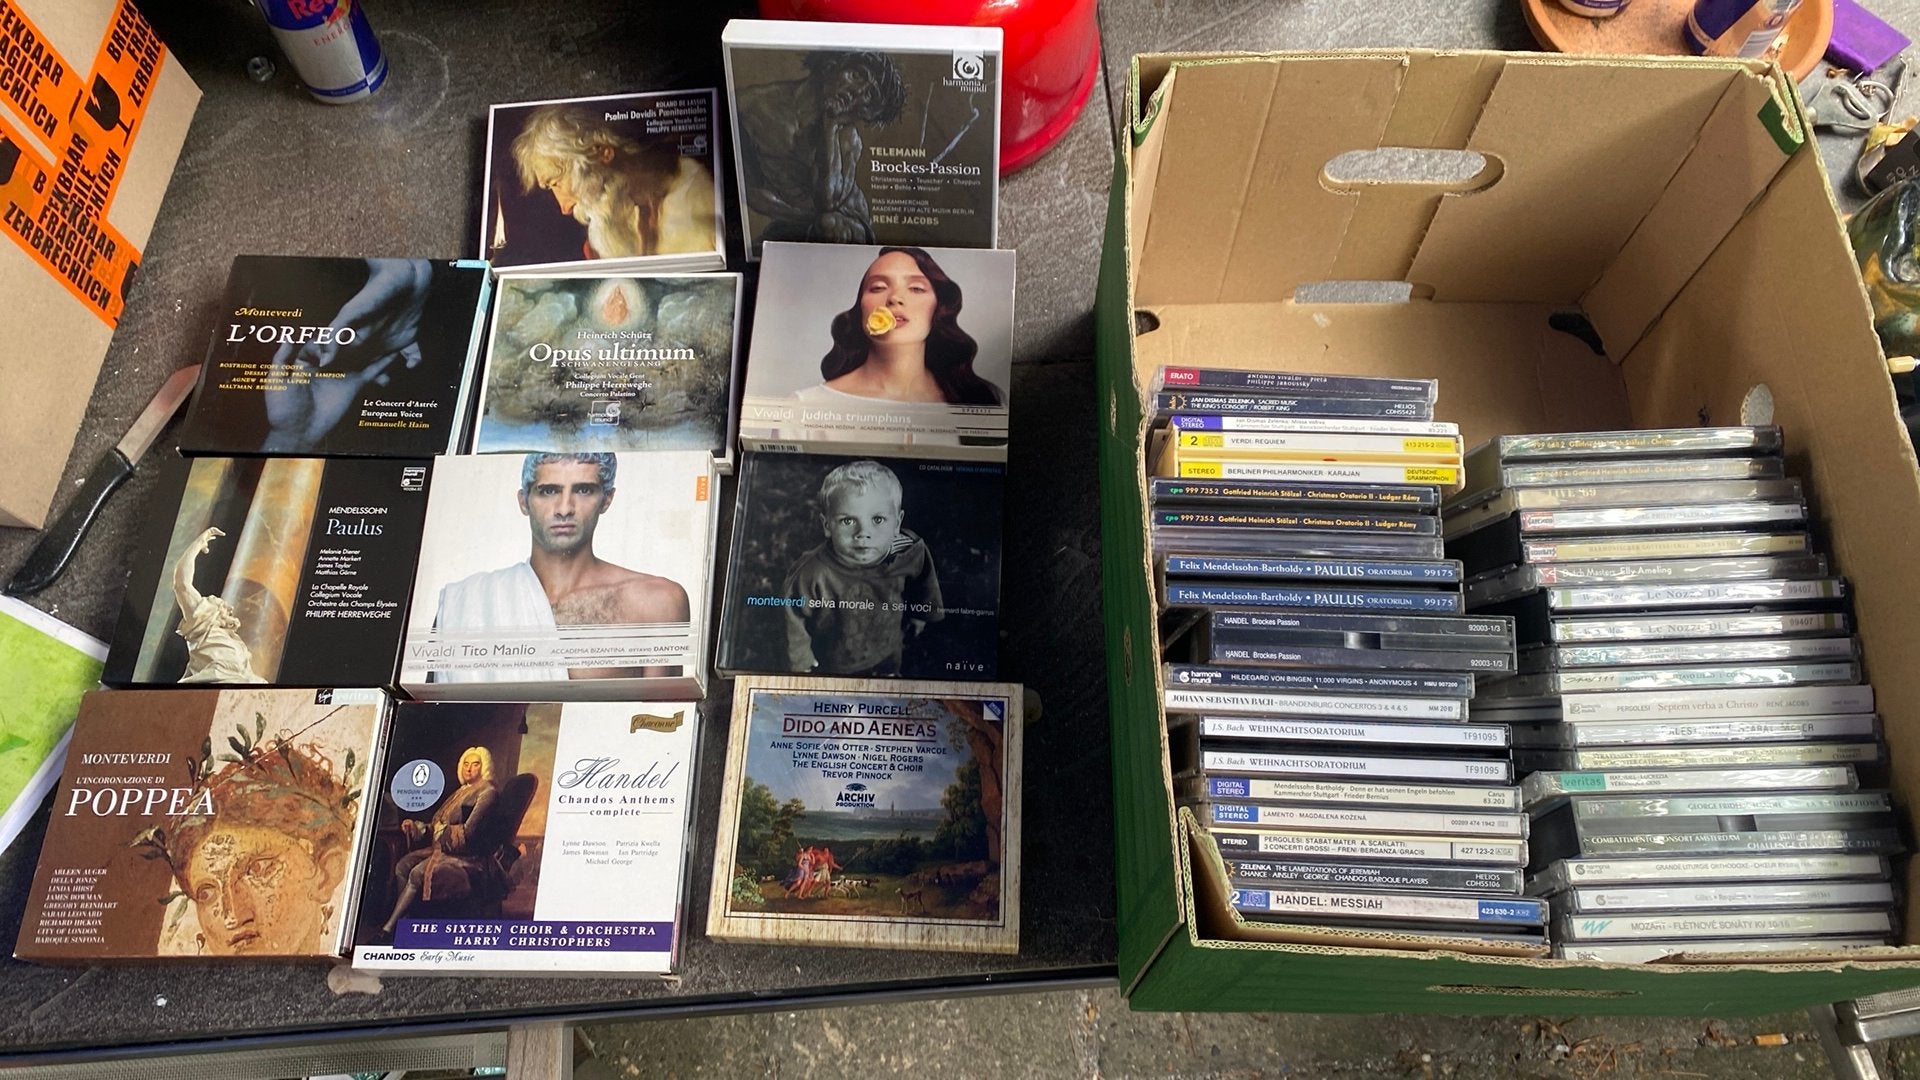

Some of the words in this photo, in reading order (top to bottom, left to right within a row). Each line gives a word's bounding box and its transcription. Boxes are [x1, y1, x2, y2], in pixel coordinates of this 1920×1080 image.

[943, 77, 981, 87] harmonia
[960, 84, 987, 92] mundi
[605, 112, 628, 121] Psalmi
[631, 109, 656, 119] Davidis
[870, 147, 926, 157] TELEMANN
[871, 160, 981, 175] Brockes-Passion
[873, 214, 898, 223] RENÉ
[902, 216, 939, 225] JACOBS
[38, 205, 97, 271] FRAGILE
[3, 201, 111, 311] ZERBRECHLICH
[234, 307, 303, 318] Monteverdi
[226, 324, 356, 346] L'ORFEO
[577, 331, 618, 339] Heinrich
[620, 331, 652, 339] Schütz
[529, 342, 591, 367] Opus
[599, 342, 695, 361] ultimum
[565, 381, 600, 390] Philippe
[602, 381, 652, 390] Herreweghe
[375, 399, 405, 407] Concert
[361, 409, 399, 418] European
[400, 410, 423, 418] Voices
[753, 407, 795, 420] Vivaldi
[800, 406, 842, 423] Juditha
[846, 413, 912, 425] triumphans
[358, 419, 407, 428] Emmanuelle
[1190, 435, 1198, 446] 2
[1254, 438, 1286, 446] REQUIEM
[1188, 467, 1216, 475] STEREO
[1227, 467, 1262, 475] BERLINER
[1263, 468, 1324, 476] PHILHARMONIKER
[1328, 469, 1360, 477] KARAJAN
[1406, 474, 1450, 482] GRAMMOPHON
[1185, 487, 1198, 495] 999
[1253, 490, 1279, 498] Heinrich
[1307, 491, 1338, 499] Christmas
[326, 518, 384, 536] Paulus
[1248, 516, 1275, 524] Heinrich
[1303, 518, 1335, 527] Christmas
[1180, 561, 1200, 571] Felix
[1201, 561, 1303, 575] Mendelssohn-Bartholdy
[1314, 565, 1364, 577] PAULUS
[1368, 568, 1413, 576] ORATORIUM
[1424, 568, 1453, 577] 99175
[1638, 566, 1672, 575] Ameling
[1788, 585, 1812, 595] 99407
[747, 596, 806, 607] monteverdi
[808, 598, 836, 609] selva
[839, 599, 875, 610] morale
[892, 601, 908, 611] sei
[910, 602, 932, 613] voci
[1179, 591, 1199, 600] Felix
[1202, 591, 1303, 603] Mendelssohn-Bartholdy
[1314, 594, 1364, 605] PAULUS
[1367, 597, 1412, 605] ORATORIUM
[1424, 598, 1453, 607] 99175
[305, 610, 337, 618] PHILIPPE
[1224, 617, 1249, 625] HANDEL
[1468, 624, 1501, 633] 92003-1/3
[1790, 617, 1814, 627] 99407
[412, 646, 456, 658] Vivaldi
[461, 645, 488, 657] Tito
[493, 644, 536, 656] Manlio
[590, 646, 626, 654] BIZANTINA
[514, 660, 555, 668] HALLENBERG
[1225, 650, 1250, 659] HANDEL
[1253, 651, 1277, 660] Brockes
[1278, 653, 1301, 661] Passion
[1470, 659, 1503, 668] 92003-1/3
[946, 661, 984, 671] naïve
[1231, 674, 1269, 682] HILDEGARD
[814, 702, 853, 713] HENRY
[858, 703, 911, 715] PURCELL
[1206, 696, 1250, 704] SEBASTIAN
[1251, 698, 1274, 706] BACH
[1334, 702, 1377, 710] CONCERTOS
[1658, 702, 1690, 712] Septem
[1692, 701, 1716, 710] verba
[1726, 699, 1758, 709] Christo
[783, 718, 826, 733] DIDO
[829, 722, 865, 734] AND
[868, 721, 937, 737] AENEAS
[1226, 724, 1245, 732] Bach
[1249, 725, 1365, 737] WEIHNACHTSORATORIUM
[1463, 732, 1498, 742] TF91095
[771, 741, 794, 750] ANNE
[81, 753, 173, 765] MONTEVERDI
[1226, 757, 1246, 766] Bach
[1249, 759, 1367, 770] WEIHNACHTSORATORIUM
[1465, 765, 1499, 775] TF91095
[558, 757, 679, 789] Handel
[76, 776, 153, 785] L'INCORONAZIONE
[1564, 777, 1601, 787] veritas
[1274, 782, 1314, 792] Mendelssohn
[1315, 784, 1345, 793] Bartholdy
[64, 787, 216, 817] POPPEA
[559, 795, 614, 804] Chandos
[620, 795, 675, 804] Anthems
[836, 792, 875, 802] ARCHIV
[590, 809, 641, 817] complete
[1289, 866, 1337, 874] LAMENTATIONS
[1475, 873, 1500, 881] HELIOS
[1276, 895, 1329, 906] HANDEL:
[1330, 897, 1383, 910] MESSIAH
[411, 923, 438, 934] THE
[445, 923, 502, 934] SIXTEEN
[510, 924, 553, 935] CHOIR
[576, 925, 656, 936] ORCHESTRA
[453, 936, 500, 946] HARRY
[509, 936, 611, 947] CHRISTOPHERS
[363, 952, 416, 961] CHANDOS
